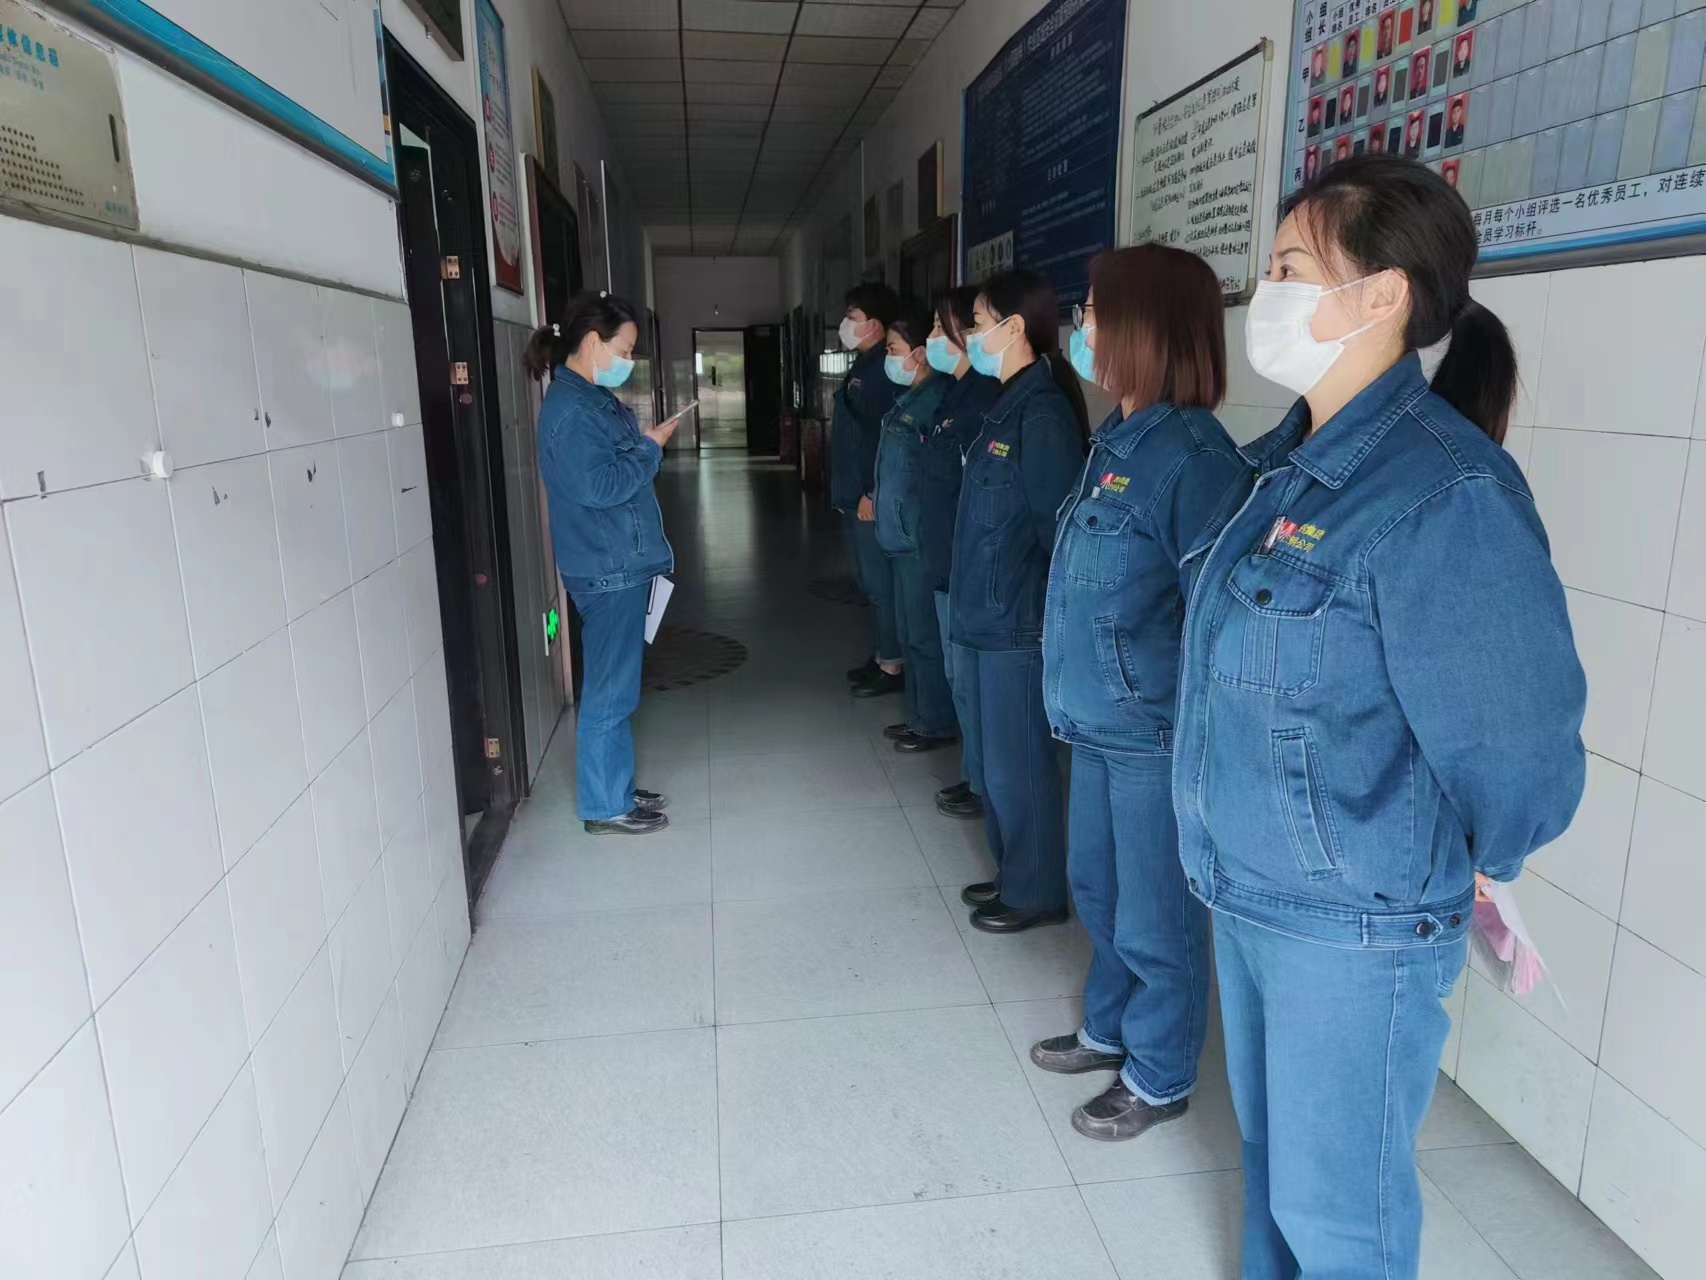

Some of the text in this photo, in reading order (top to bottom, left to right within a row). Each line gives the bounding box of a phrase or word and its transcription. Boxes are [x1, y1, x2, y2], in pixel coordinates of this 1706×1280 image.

[1304, 10, 1313, 43] 小组
[1319, 1, 1328, 36] 组长
[1302, 67, 1310, 83] 甲
[1298, 118, 1305, 133] 乙
